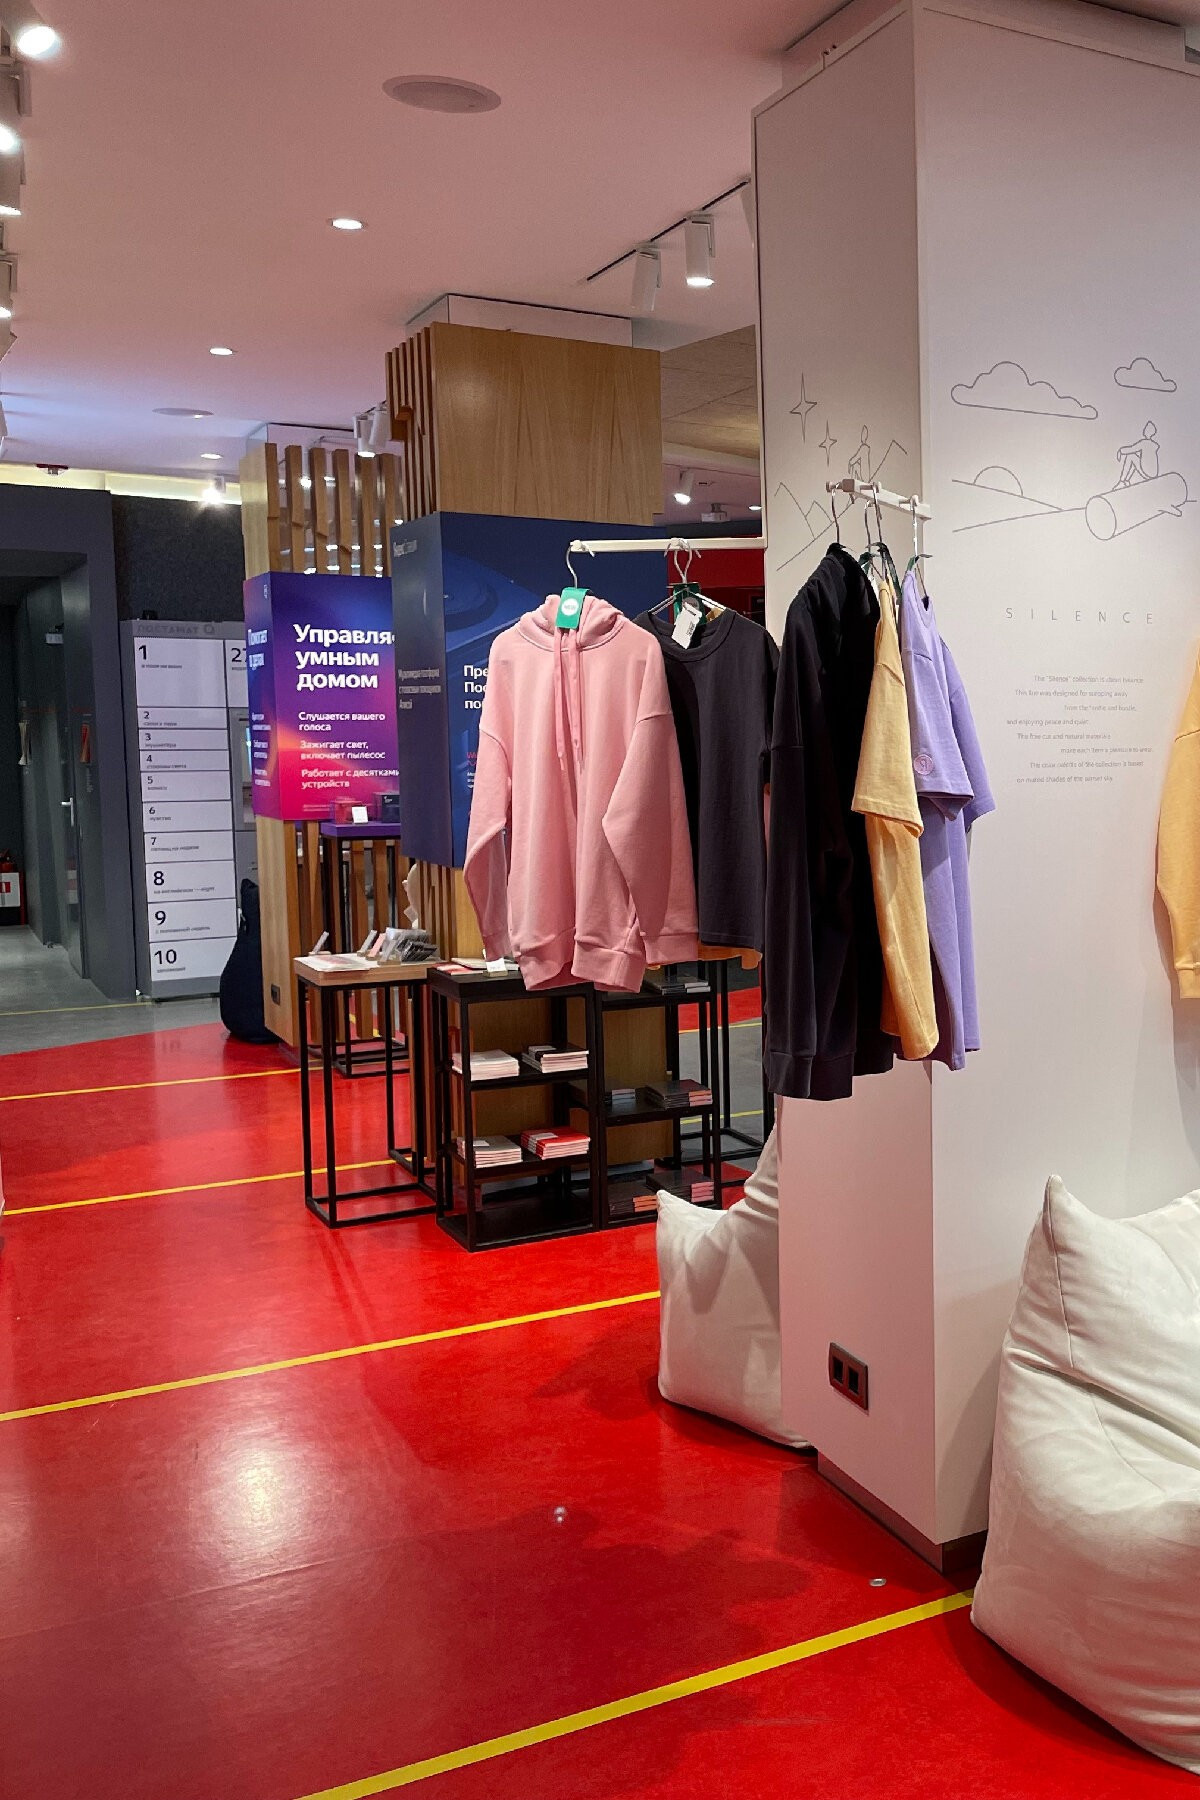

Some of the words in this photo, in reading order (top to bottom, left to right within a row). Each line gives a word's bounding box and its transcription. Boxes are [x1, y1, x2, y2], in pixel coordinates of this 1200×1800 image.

[1005, 607, 1153, 625] SILENCE
[293, 623, 396, 648] Управля
[138, 644, 147, 660] 1
[295, 651, 380, 670] умным
[296, 673, 379, 692] домом
[1053, 689, 1078, 698] designed
[143, 710, 150, 719] 2
[298, 711, 350, 723] Слушается
[351, 713, 386, 721] вашего
[298, 723, 332, 731] голоса
[1018, 719, 1043, 727] enjoying
[145, 732, 151, 741] 3
[300, 740, 344, 750] Зажигает
[346, 741, 369, 750] свет,
[146, 754, 153, 763] 4
[301, 751, 344, 760] включает
[346, 751, 386, 760] пылесос
[302, 768, 343, 777] Работает
[147, 776, 154, 785] 5
[302, 779, 350, 790] устройств
[149, 806, 156, 815] 6
[150, 837, 157, 846] 7
[153, 871, 165, 886] 8
[154, 910, 167, 926] 9
[154, 949, 177, 965] 10
